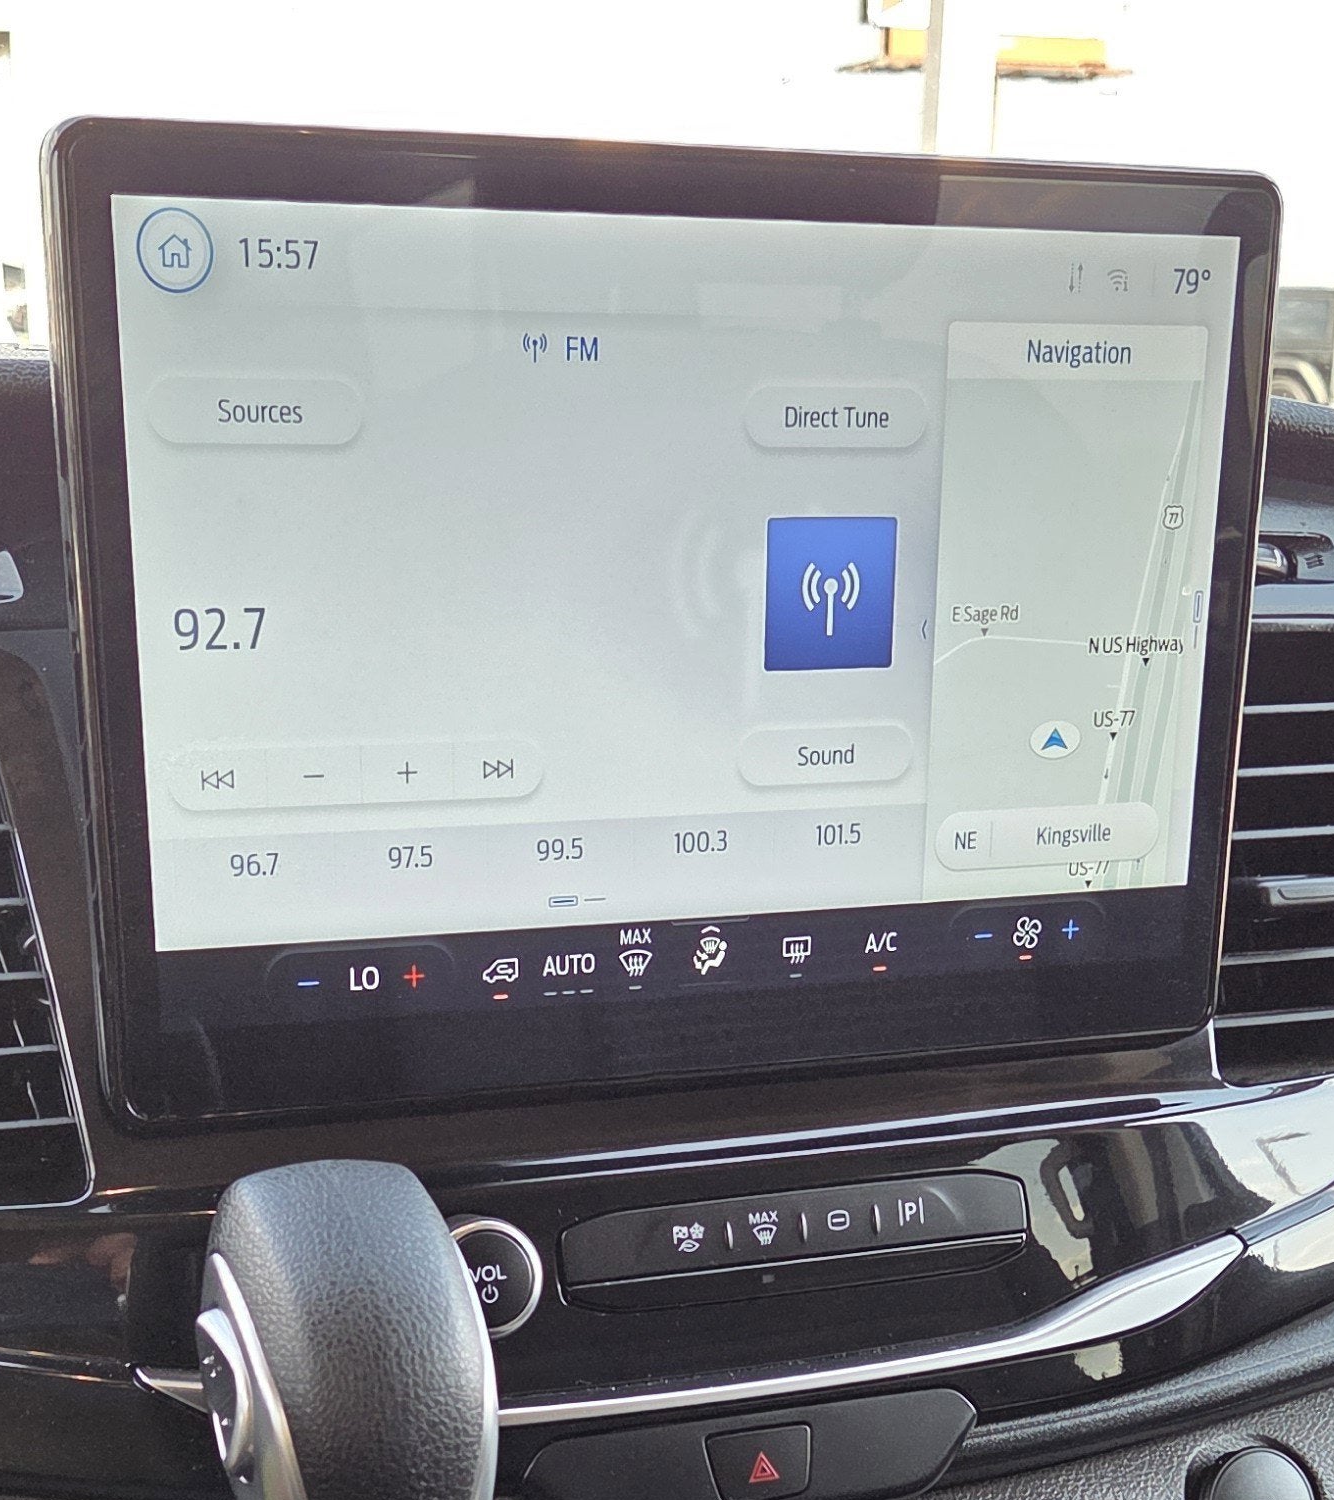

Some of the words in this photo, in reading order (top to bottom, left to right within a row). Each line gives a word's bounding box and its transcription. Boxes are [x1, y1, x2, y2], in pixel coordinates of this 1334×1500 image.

[238, 237, 320, 270] 15:57
[565, 336, 599, 361] FM
[1026, 338, 1132, 367] Navigation
[217, 398, 303, 423] Sources
[784, 405, 839, 429] Direct
[844, 406, 889, 429] Tune
[1169, 512, 1179, 524] 77
[952, 607, 961, 622] E
[963, 606, 997, 625] Sage
[1000, 604, 1019, 621] Rd
[173, 607, 265, 650] 92.7
[1088, 637, 1099, 653] N
[1102, 636, 1123, 653] US
[1093, 710, 1136, 727] US-77
[797, 744, 855, 767] Sound
[673, 829, 728, 854] 100.3
[815, 823, 861, 846] 101.5
[954, 831, 977, 851] NE
[1036, 823, 1111, 848] Kingsville
[388, 845, 433, 870] 97.5
[536, 837, 584, 862] 99.5
[230, 852, 279, 877] 96.7
[619, 927, 652, 945] MAX
[865, 931, 897, 955] A/C
[542, 952, 596, 976] AUTO
[349, 966, 380, 991] LO
[748, 1210, 778, 1226] MAX
[468, 1264, 507, 1283] VOL
